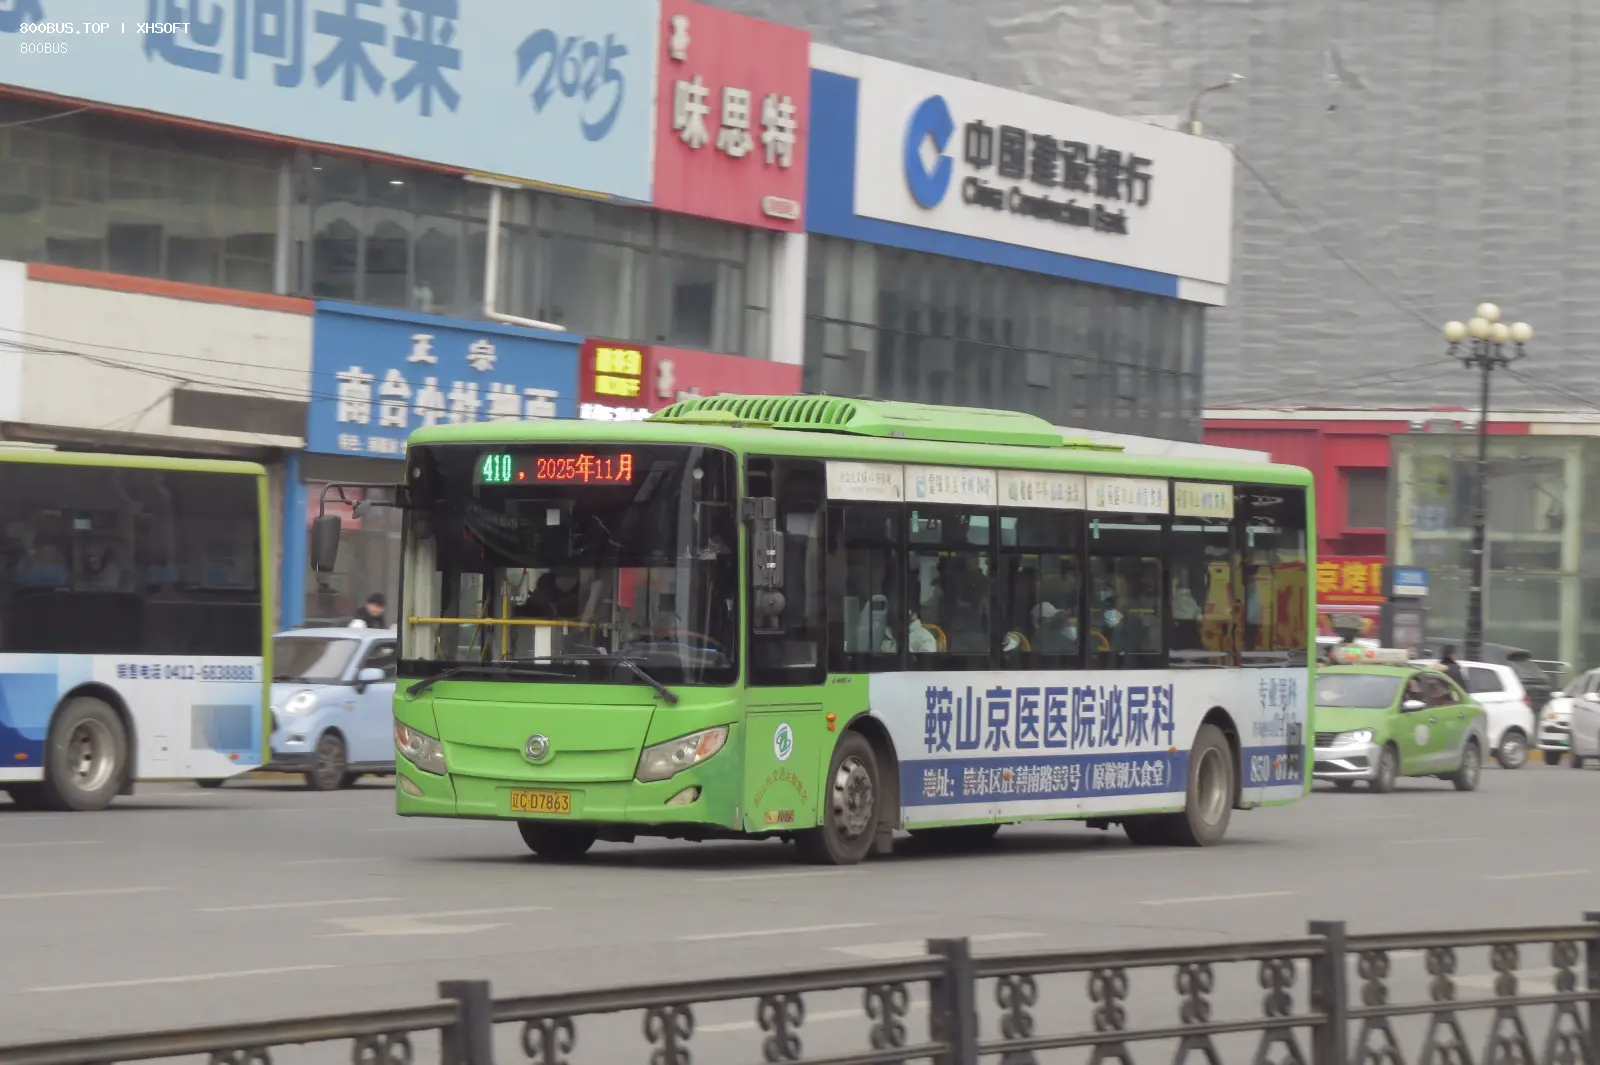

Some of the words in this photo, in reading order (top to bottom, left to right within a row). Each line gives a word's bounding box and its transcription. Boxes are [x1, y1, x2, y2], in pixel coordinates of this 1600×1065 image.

[673, 75, 797, 167] 味思特
[964, 119, 1154, 207] 中国建设银行
[483, 454, 512, 482] 410
[924, 683, 1175, 753] 鞍山京医医院泌尿科
